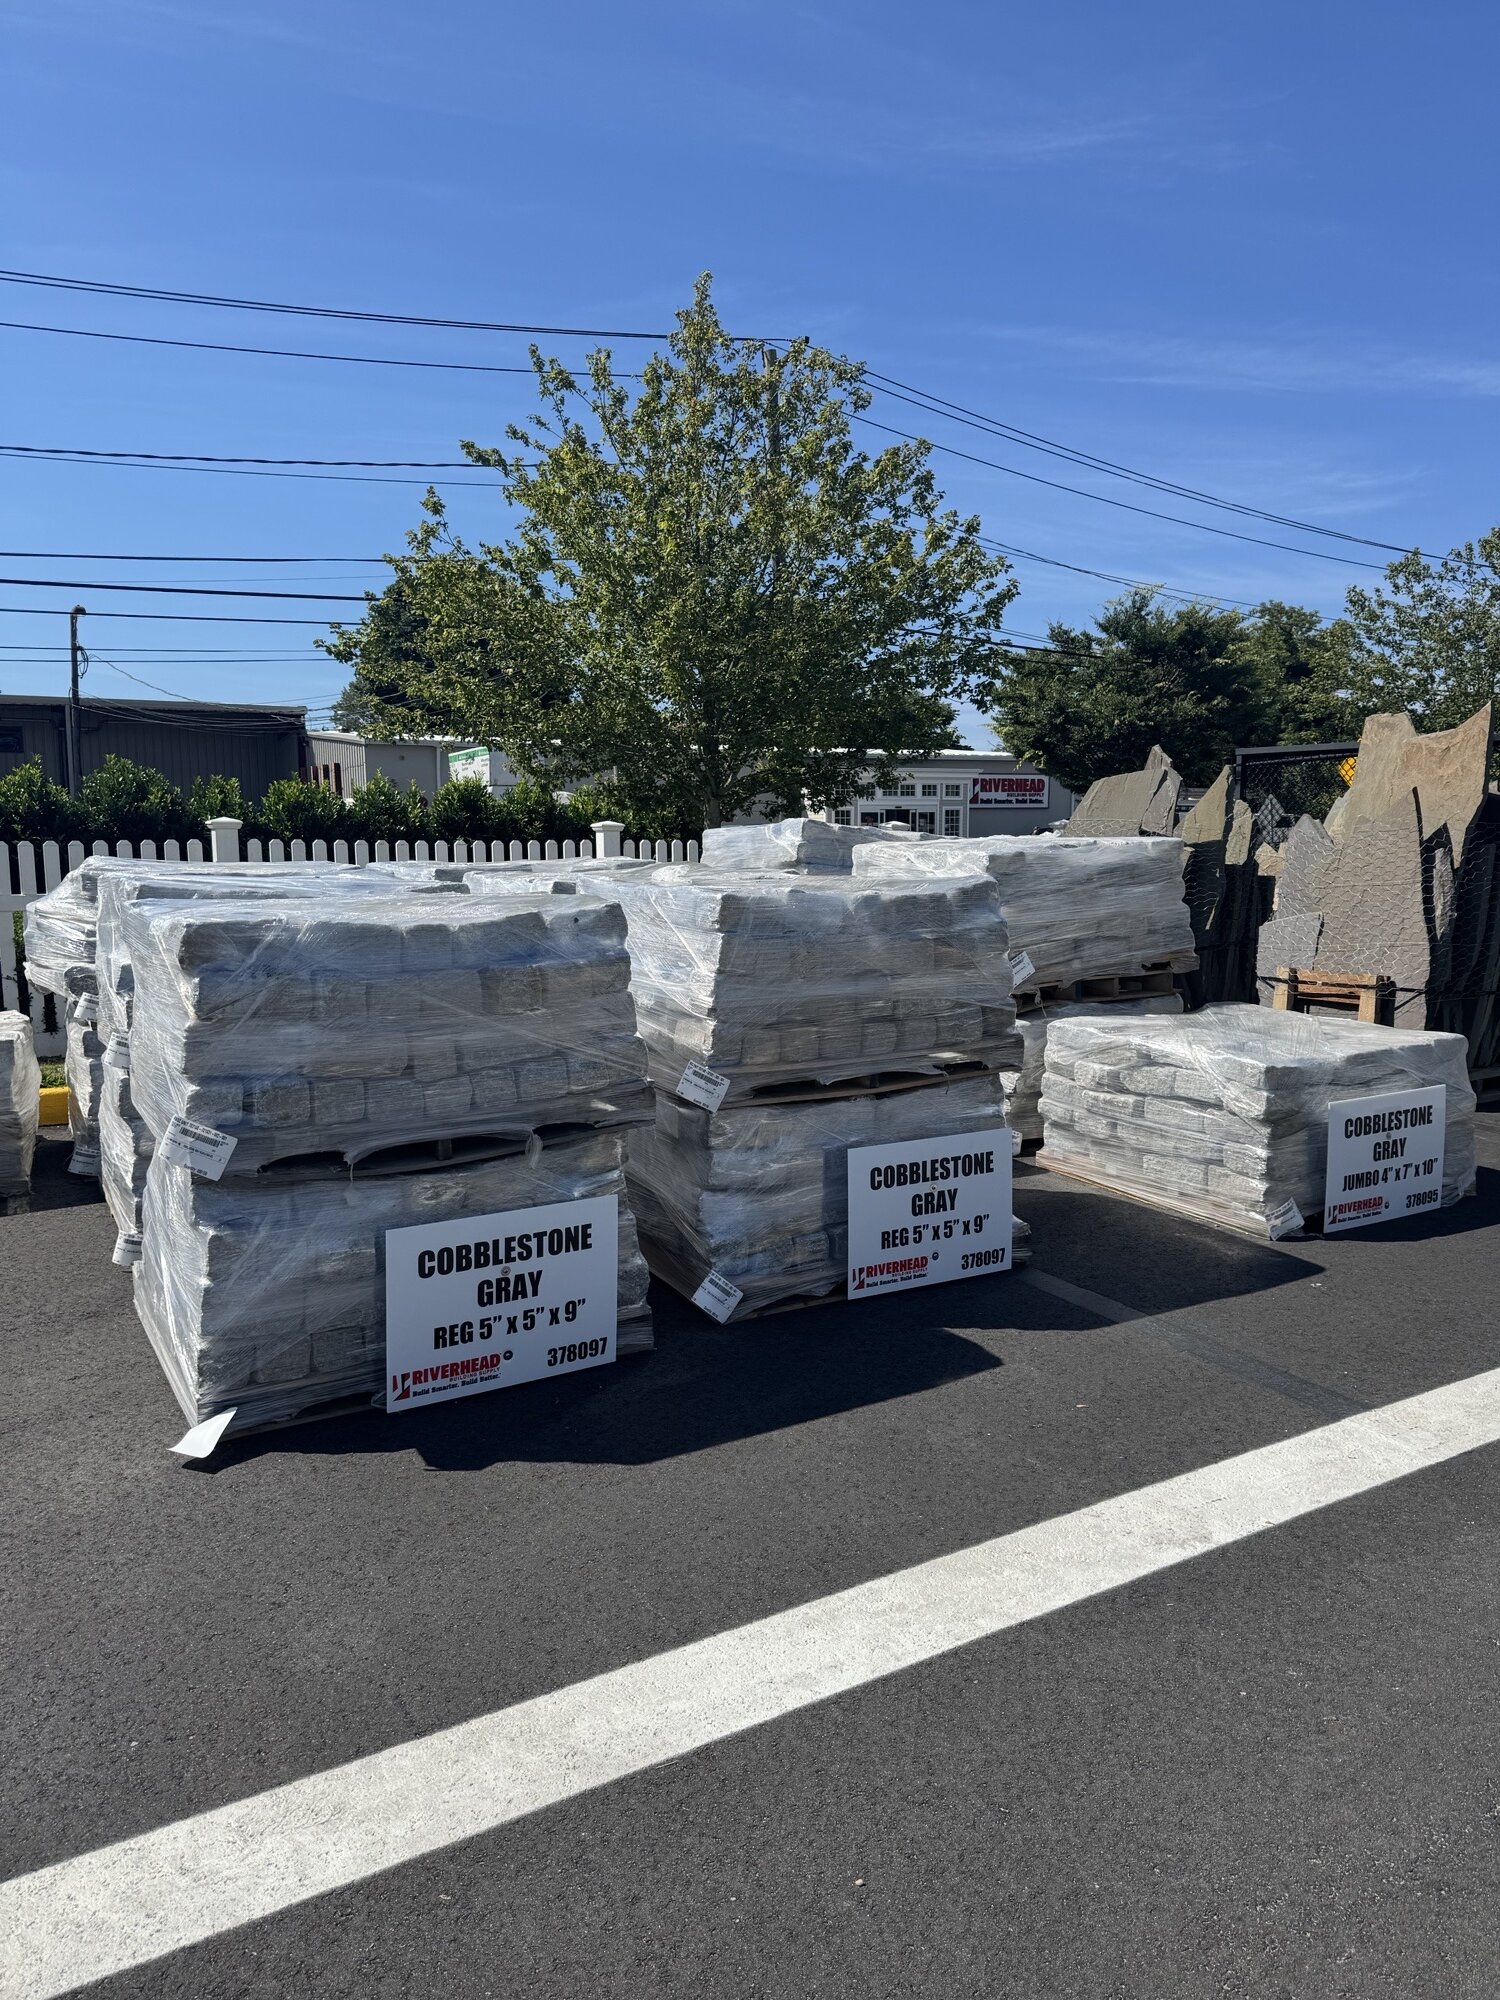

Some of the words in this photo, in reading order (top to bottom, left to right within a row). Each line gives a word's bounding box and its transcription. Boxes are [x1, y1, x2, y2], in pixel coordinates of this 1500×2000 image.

[980, 778, 1046, 793] RIVERHEAD
[1344, 1105, 1433, 1139] COBBLESTONE
[1373, 1137, 1407, 1162] GRAY
[870, 1151, 994, 1191] COBBLESTONE
[1342, 1169, 1379, 1192] JUMBO
[1381, 1166, 1393, 1184] 4"
[1402, 1162, 1413, 1180] 7"
[1422, 1157, 1438, 1176] 10"
[911, 1188, 958, 1217] GRAY
[1338, 1196, 1383, 1215] RIVERHEAD
[1405, 1189, 1439, 1209] 378095
[418, 1223, 592, 1279] COBBLESTONE
[881, 1227, 909, 1250] REG
[866, 1255, 929, 1278] RIVERHEAD
[961, 1248, 1006, 1270] 378097
[477, 1270, 543, 1308] GRAY
[433, 1321, 474, 1350] REG
[547, 1337, 608, 1367] 378097
[412, 1353, 501, 1385] RIVERHEAD
[449, 1372, 478, 1382] BUILDING
[478, 1367, 501, 1375] SUPPLY
[412, 1387, 430, 1397] Build
[431, 1382, 460, 1393] Smarter.
[461, 1377, 478, 1386] Build
